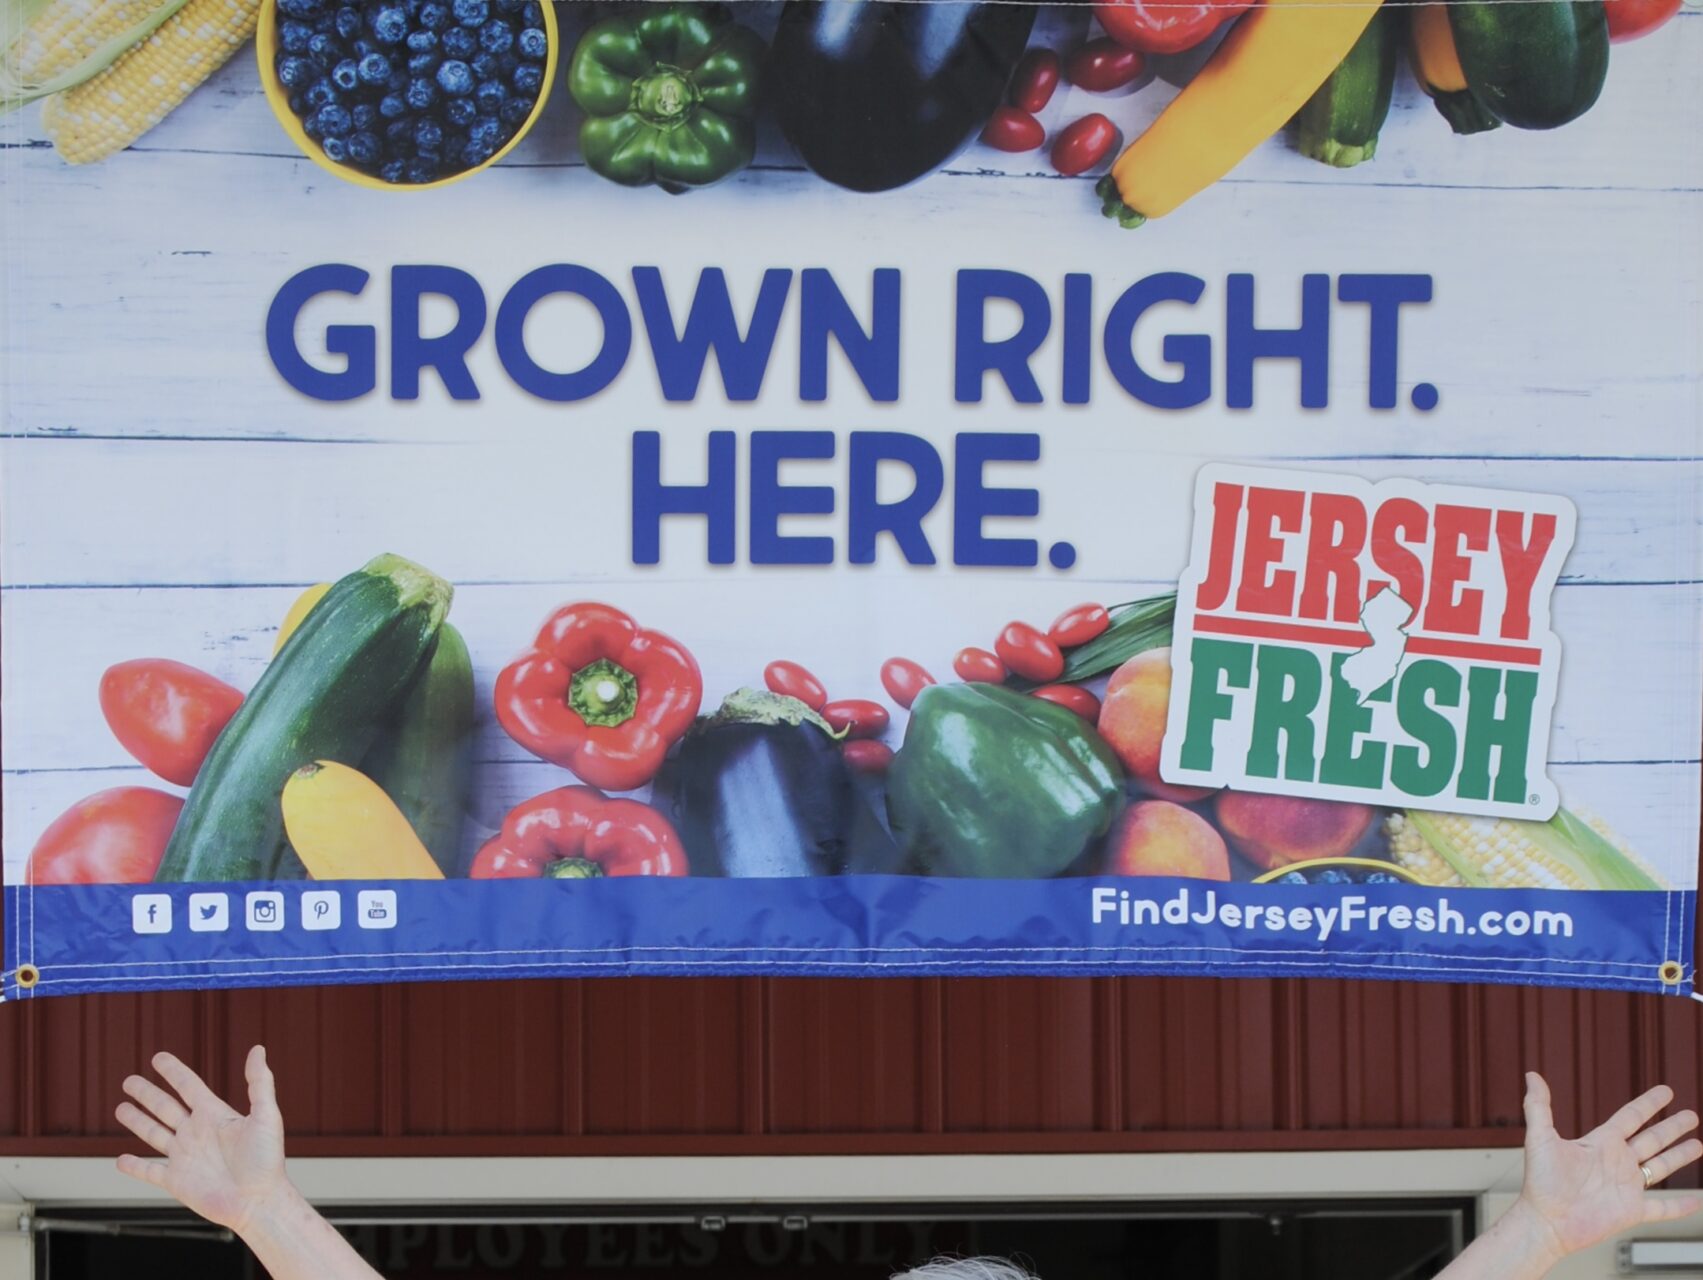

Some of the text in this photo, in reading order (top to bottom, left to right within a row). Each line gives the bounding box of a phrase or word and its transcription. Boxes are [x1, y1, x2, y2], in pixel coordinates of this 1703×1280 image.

[265, 262, 1440, 410] GROWN RIGHT.
[631, 430, 1077, 570] HERE.
[1195, 481, 1557, 641] JERSEY
[1179, 637, 1539, 805] FRESH
[370, 900, 384, 909] You
[1091, 887, 1574, 941] FindJerseyFresh.com
[343, 1225, 720, 1269] PLOYEES
